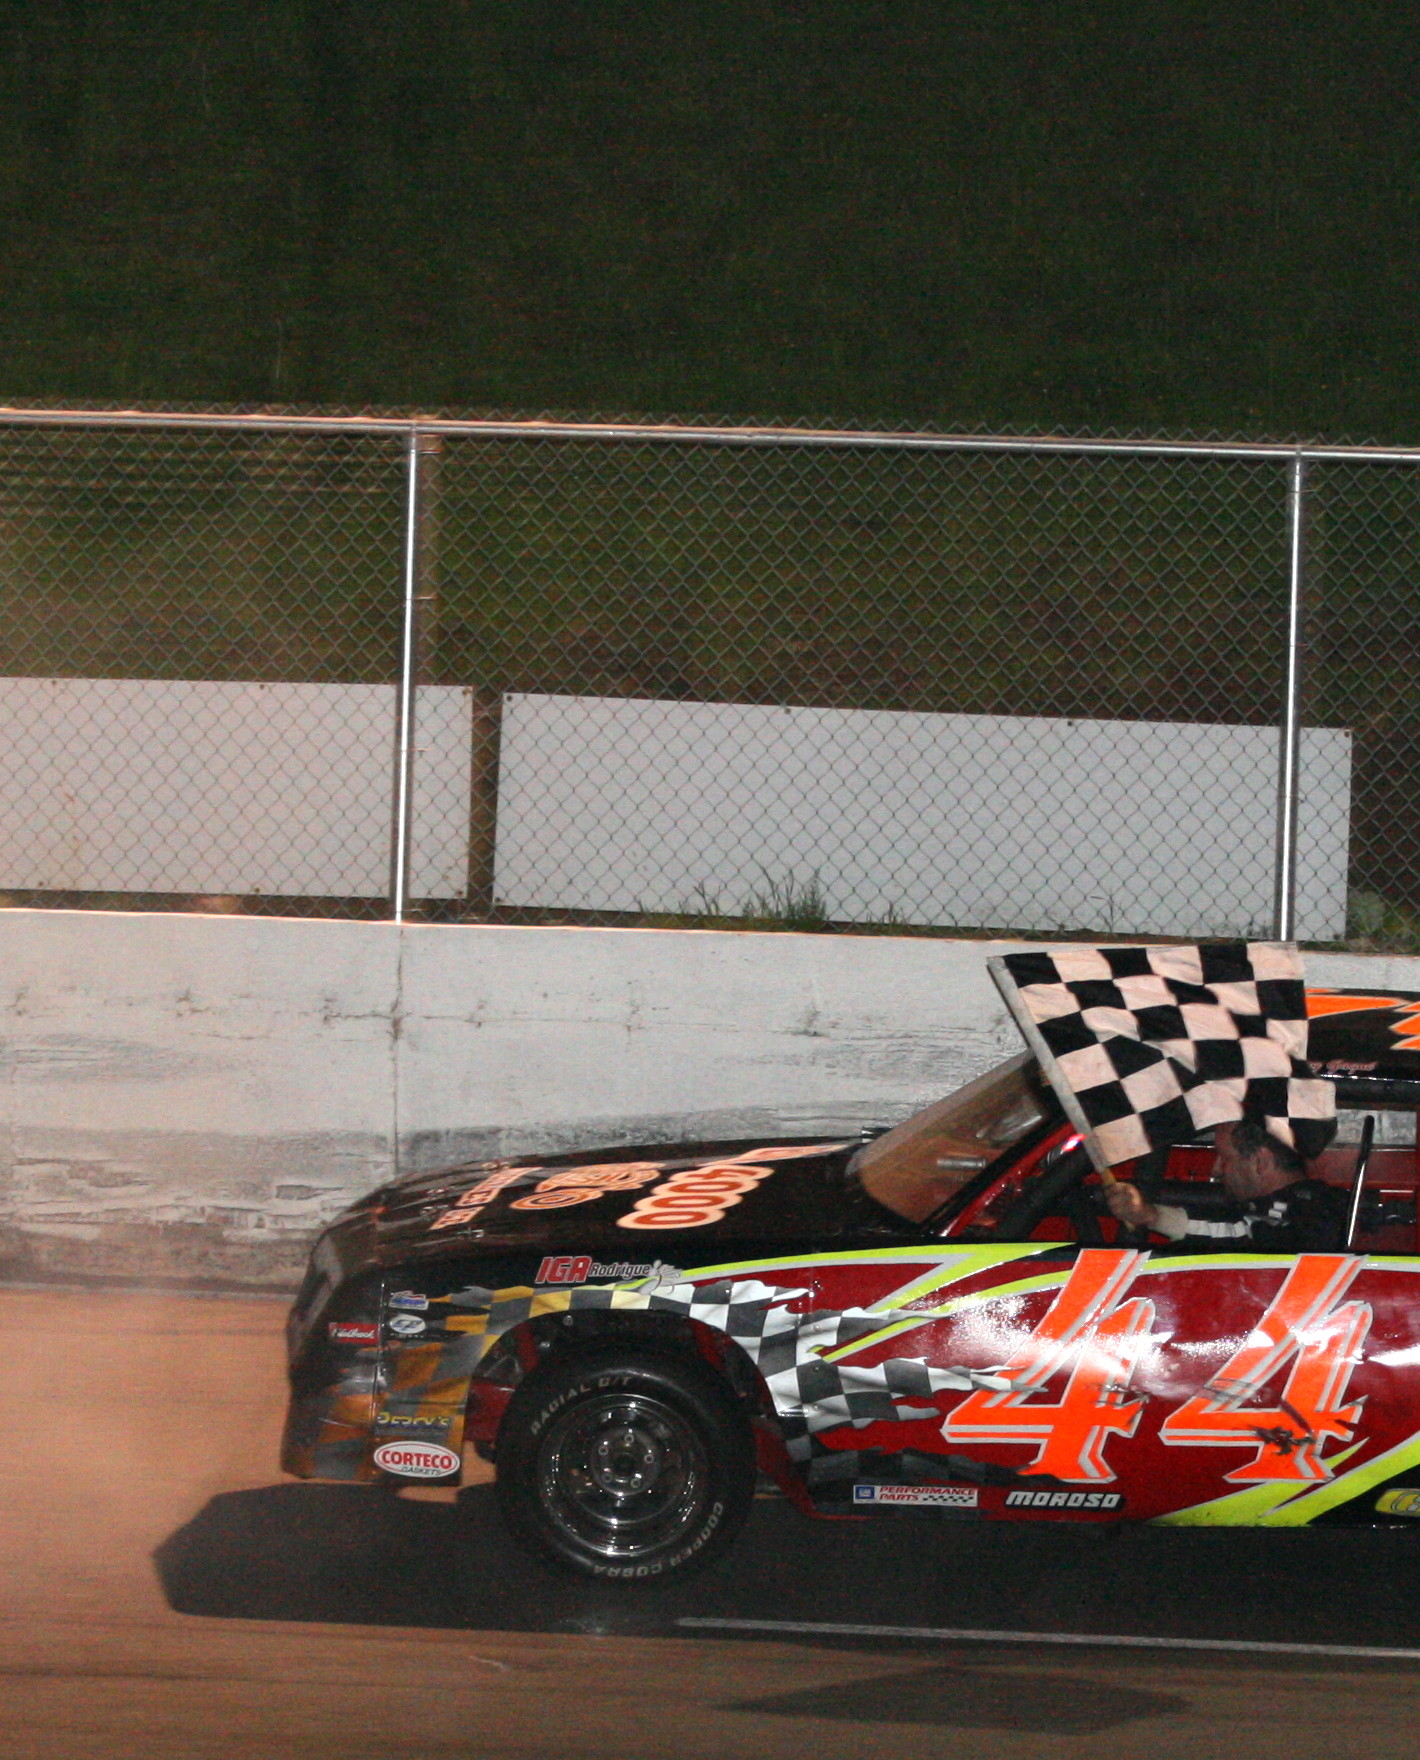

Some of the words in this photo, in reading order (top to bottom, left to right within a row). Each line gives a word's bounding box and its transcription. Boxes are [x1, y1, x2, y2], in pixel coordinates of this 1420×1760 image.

[535, 1256, 592, 1284] IGA
[941, 1249, 1370, 1483] 44
[531, 1382, 591, 1435] RADIAL
[382, 1450, 452, 1469] CORTECO
[880, 1486, 975, 1496] PERFORMANCE
[880, 1493, 919, 1501] PARTS
[1006, 1490, 1121, 1508] MOROSO
